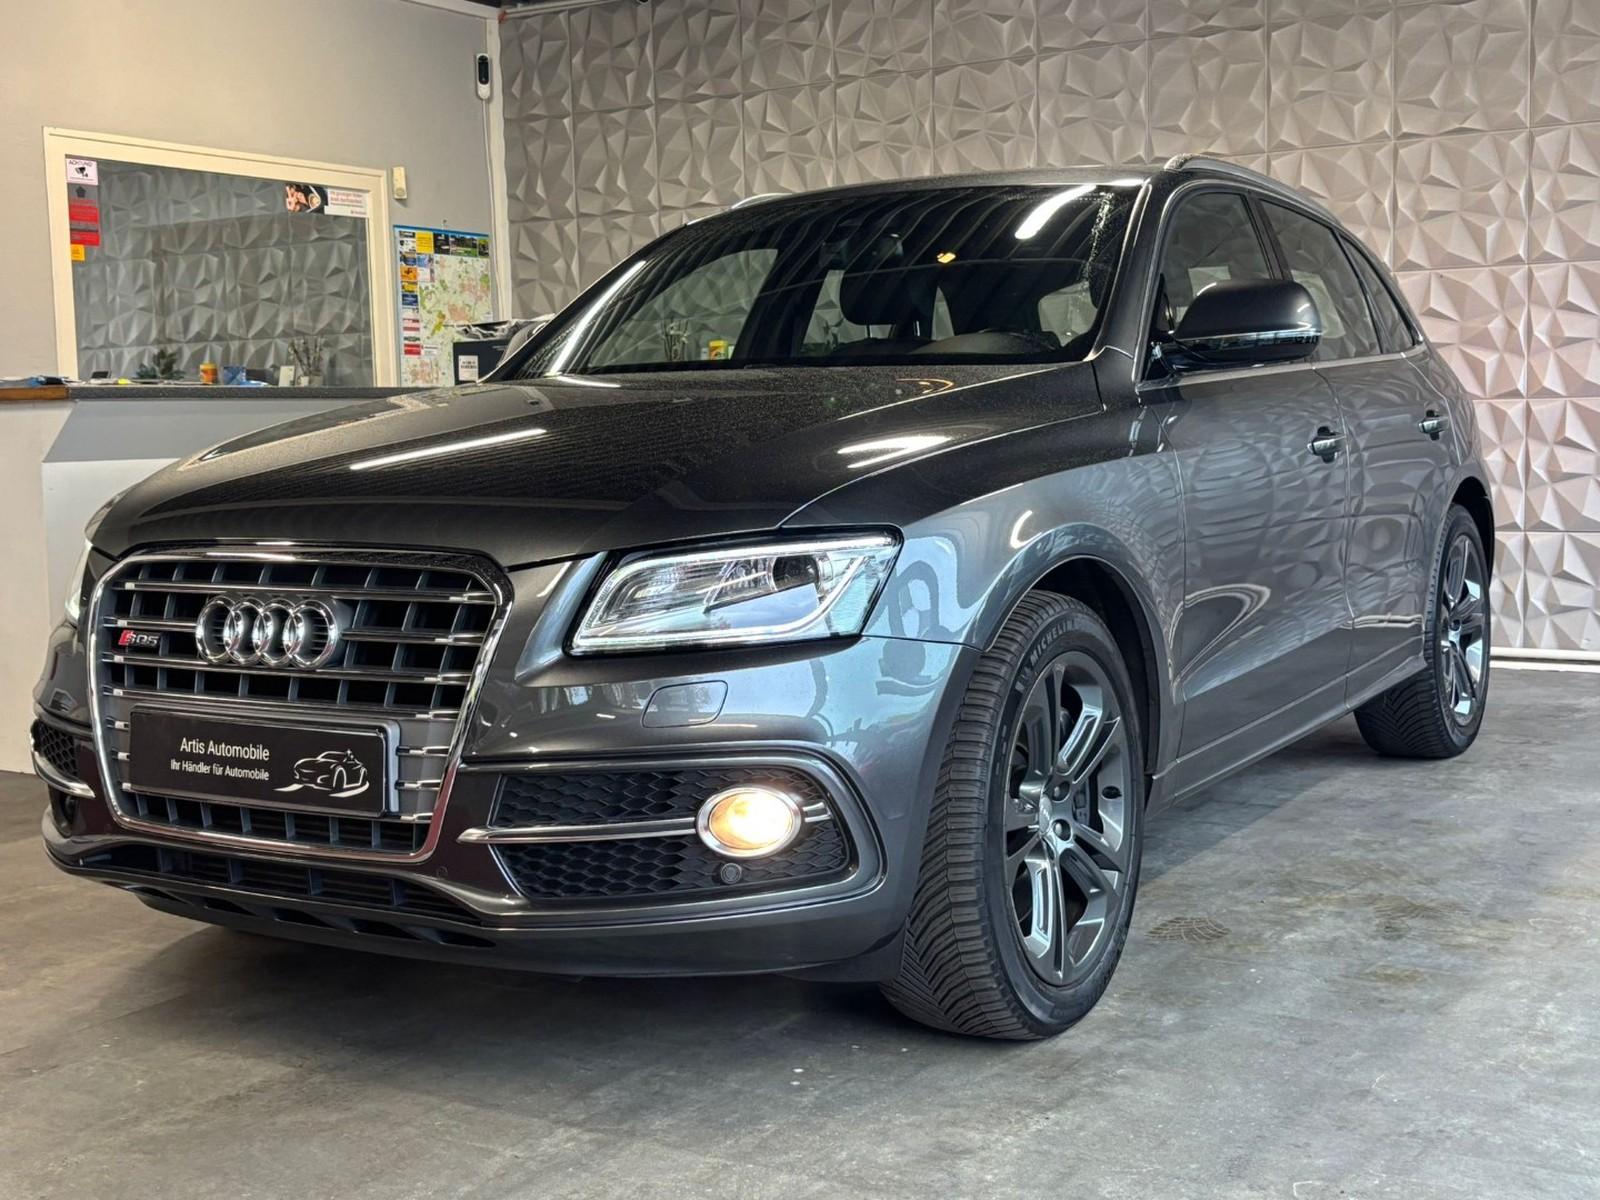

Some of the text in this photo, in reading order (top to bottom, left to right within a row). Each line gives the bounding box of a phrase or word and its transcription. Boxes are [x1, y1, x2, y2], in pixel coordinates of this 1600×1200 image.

[1030, 618, 1075, 667] MICHELIN
[180, 737, 270, 761] Artis Automobile
[170, 758, 270, 781] Ihr Händler für Automobile
